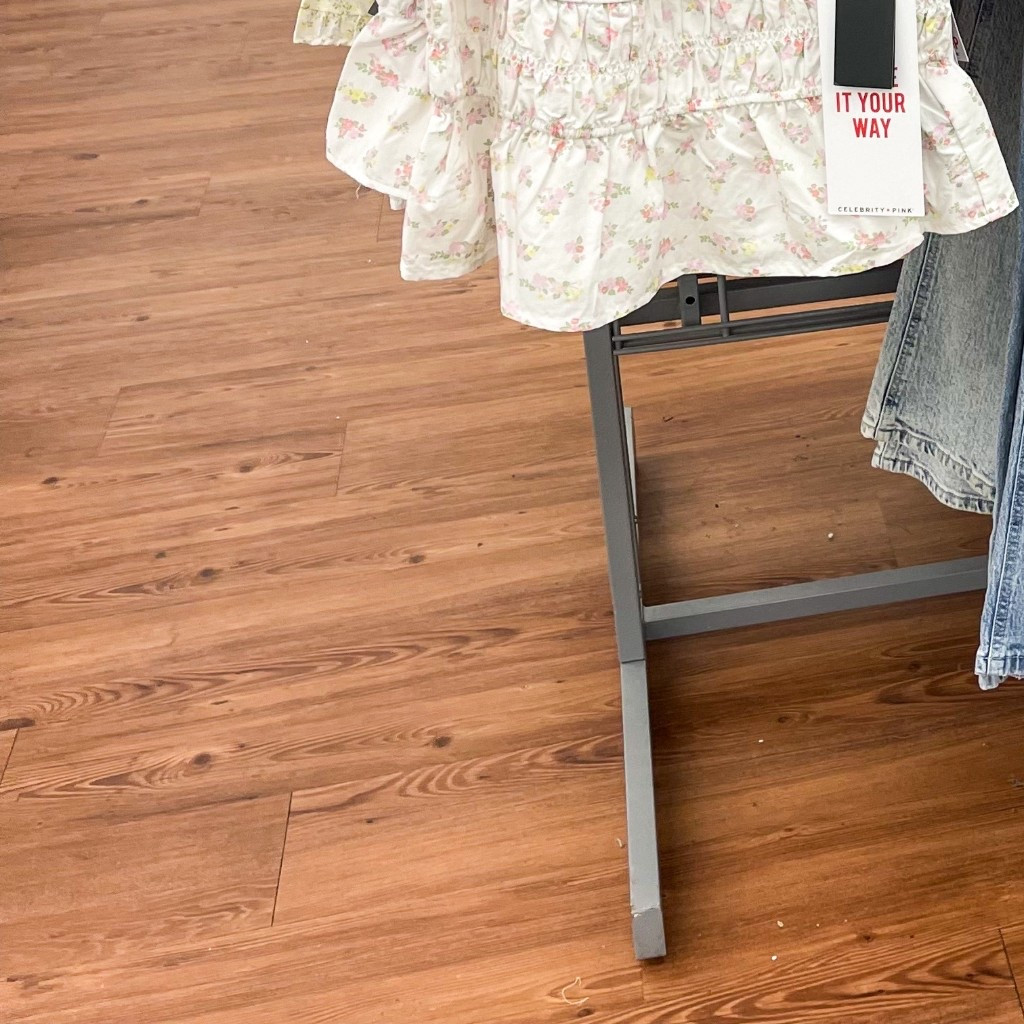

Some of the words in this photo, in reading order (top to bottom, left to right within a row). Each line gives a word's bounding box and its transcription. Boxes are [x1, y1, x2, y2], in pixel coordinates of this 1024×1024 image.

[836, 92, 852, 113] IT
[857, 92, 906, 113] YOUR
[852, 117, 892, 139] WAY
